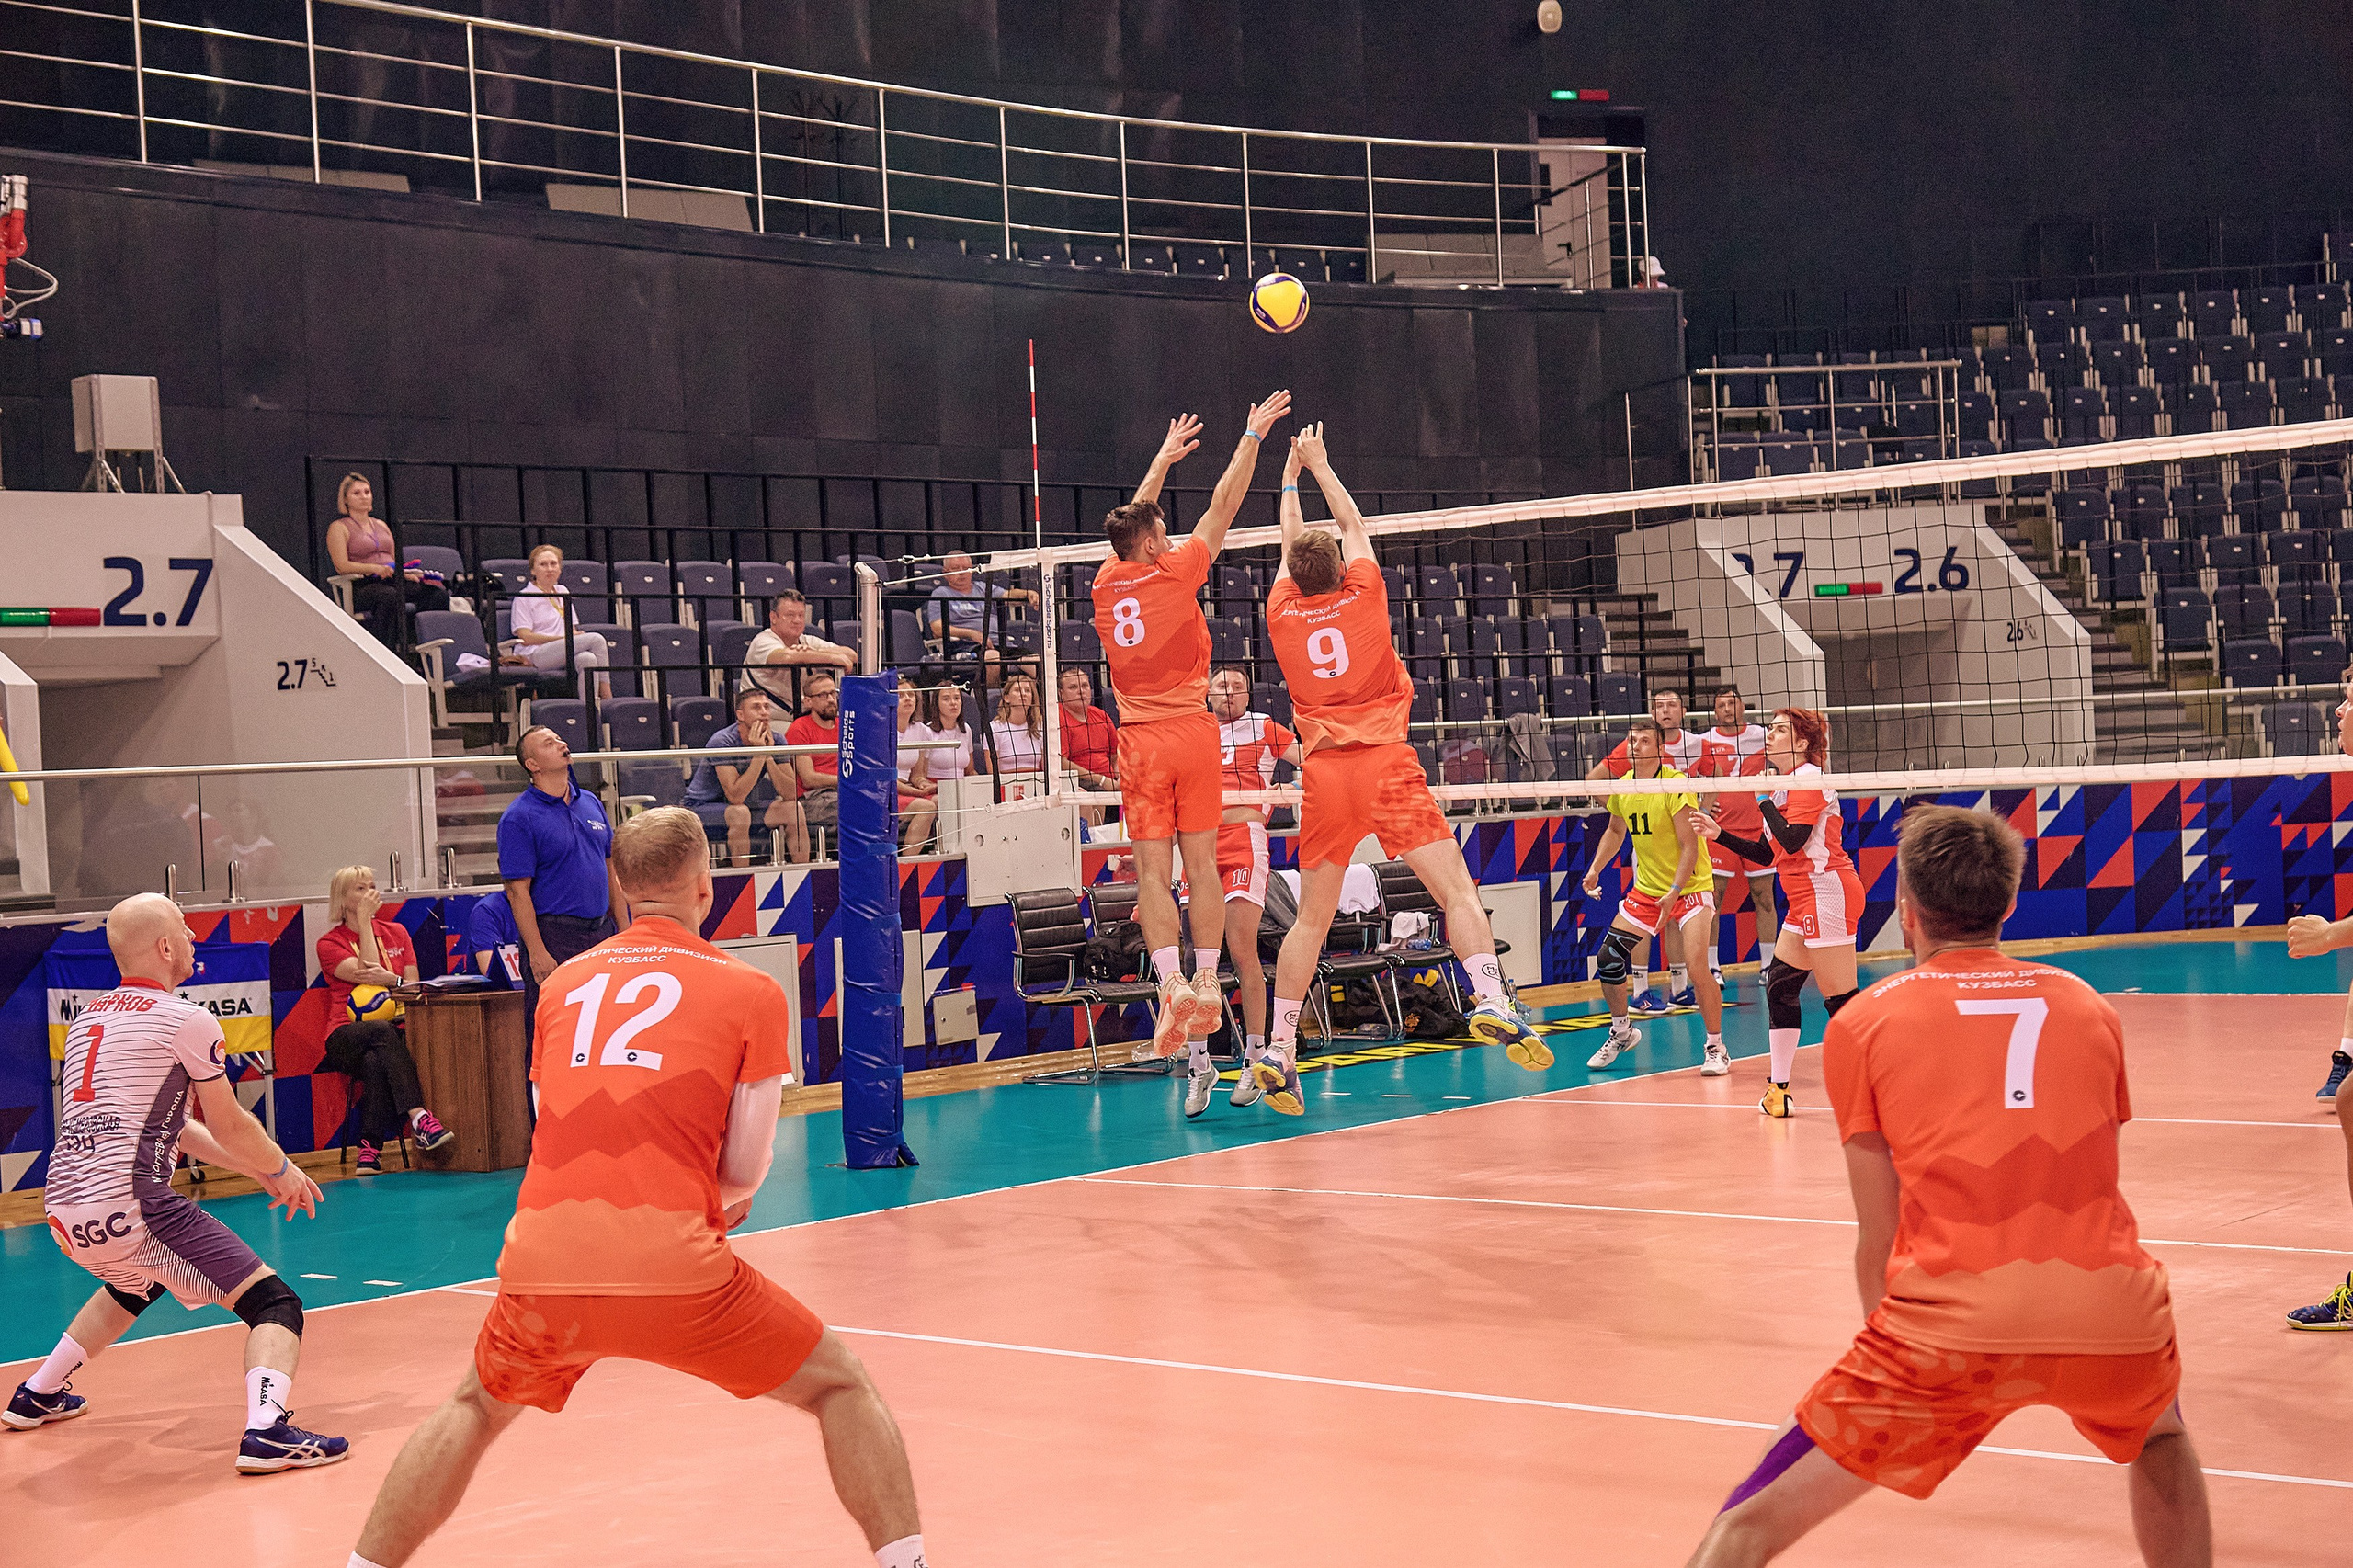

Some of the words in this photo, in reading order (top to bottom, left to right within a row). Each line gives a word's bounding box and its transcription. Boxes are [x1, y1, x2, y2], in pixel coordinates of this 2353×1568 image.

[1894, 546, 1969, 594] 2.6
[103, 556, 213, 627] 2.7
[1112, 597, 1145, 647] 8
[1307, 609, 1342, 624] КУЗБАСС
[1306, 627, 1350, 679] 9
[277, 659, 308, 690] 2.7
[1628, 812, 1653, 835] 11
[1232, 867, 1251, 887] 10
[1802, 915, 1815, 936] 8
[563, 945, 657, 967] ЭНЕРГЕТИЧЕСКИЙ
[658, 946, 728, 965] ДИВИЗИОН
[608, 955, 667, 964] КУЗБАСС
[1871, 971, 2015, 998] ЭНЕРГЕТИЧЕСКИЙ
[1957, 979, 2037, 990] КУЗБАСС
[564, 972, 683, 1071] 12
[73, 1024, 105, 1102] 1
[1954, 997, 2050, 1109] 7
[72, 1211, 132, 1249] SGC
[259, 1376, 271, 1407] MIKASA
